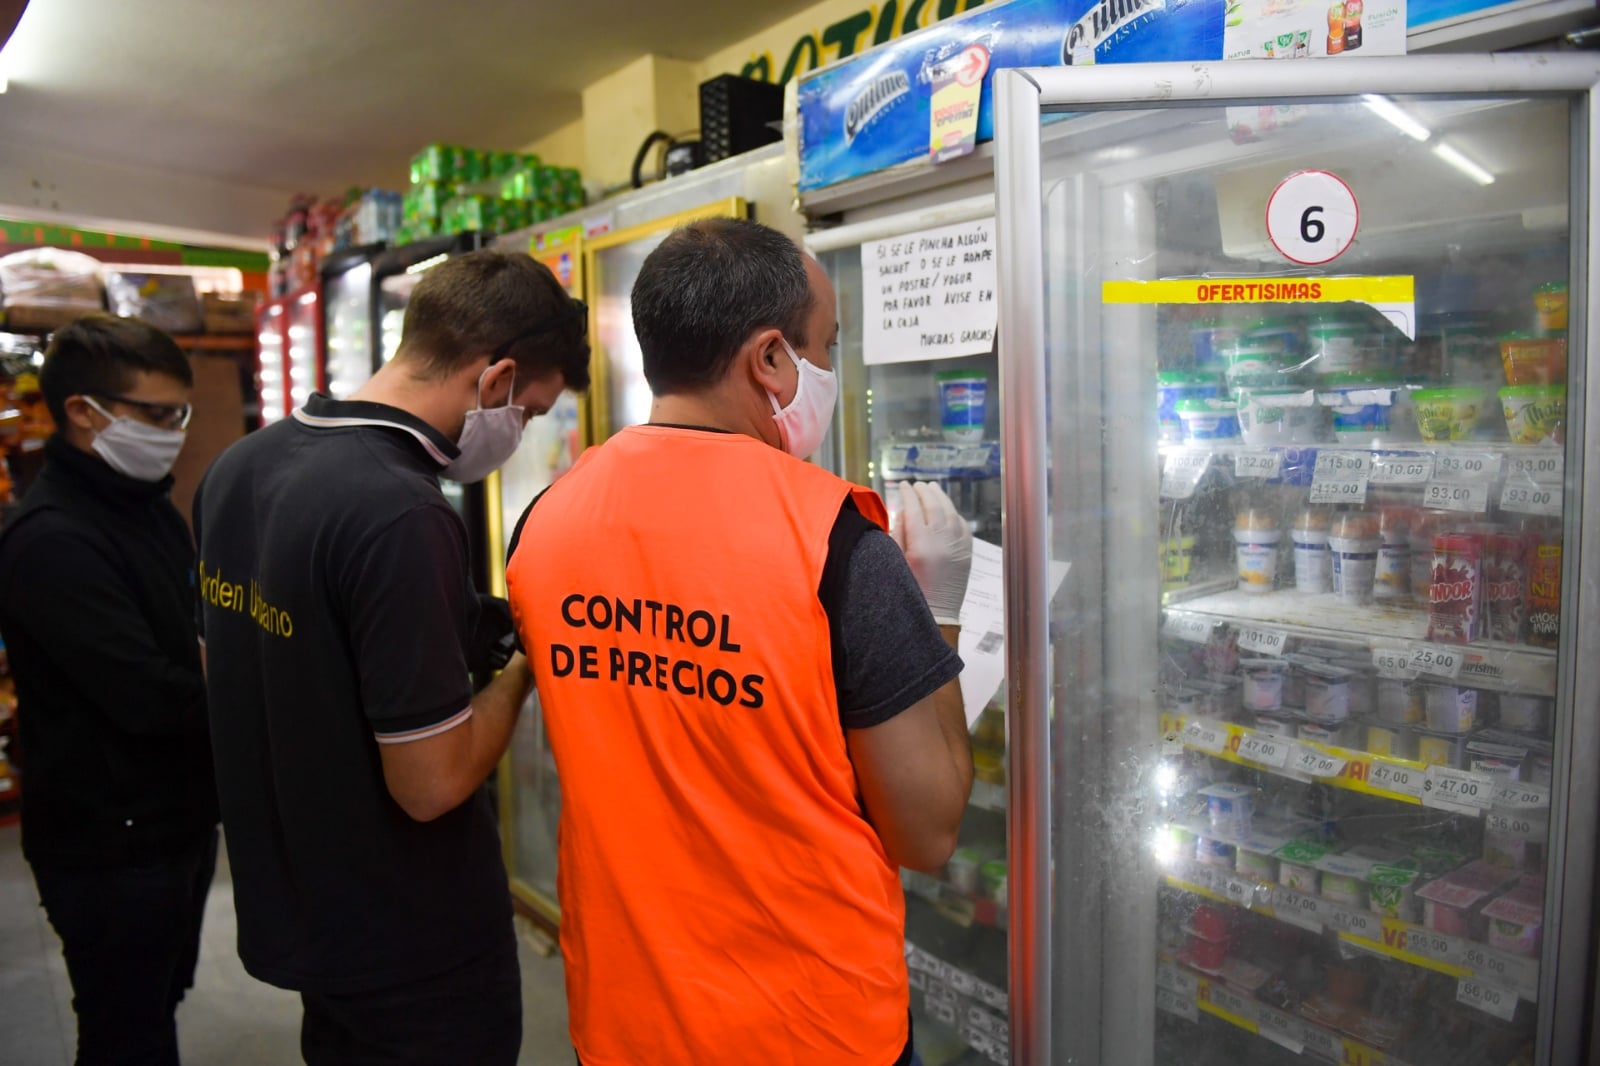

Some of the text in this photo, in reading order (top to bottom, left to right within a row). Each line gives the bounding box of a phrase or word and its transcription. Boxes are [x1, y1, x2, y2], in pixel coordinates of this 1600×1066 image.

[1300, 206, 1325, 243] 6
[891, 243, 902, 257] SE
[904, 242, 914, 255] LE
[919, 236, 953, 252] PINCHA
[880, 261, 909, 276] SACHET
[932, 257, 942, 269] SE
[946, 255, 956, 267] LE
[1197, 283, 1322, 302] OFERTISIMAS
[883, 290, 992, 312] POR FAVOR AVISE EN
[883, 316, 919, 330] LA CAJA
[1442, 458, 1482, 471] 93.00
[1515, 459, 1555, 471] 93.00
[1431, 487, 1470, 500] 93.00
[1509, 489, 1550, 505] 93.00
[561, 593, 741, 653] CONTROL
[1245, 631, 1280, 646] 101.00
[1415, 651, 1453, 667] 25.00
[551, 644, 764, 709] DE PRECIOS
[1245, 740, 1275, 756] 47.00
[1302, 755, 1333, 770] 47.00
[1375, 767, 1408, 784] 47.00
[1424, 779, 1477, 796] $ 47.00
[1500, 789, 1539, 803] 47.00
[1286, 896, 1316, 911] 47.00
[1334, 912, 1366, 929] 47.00
